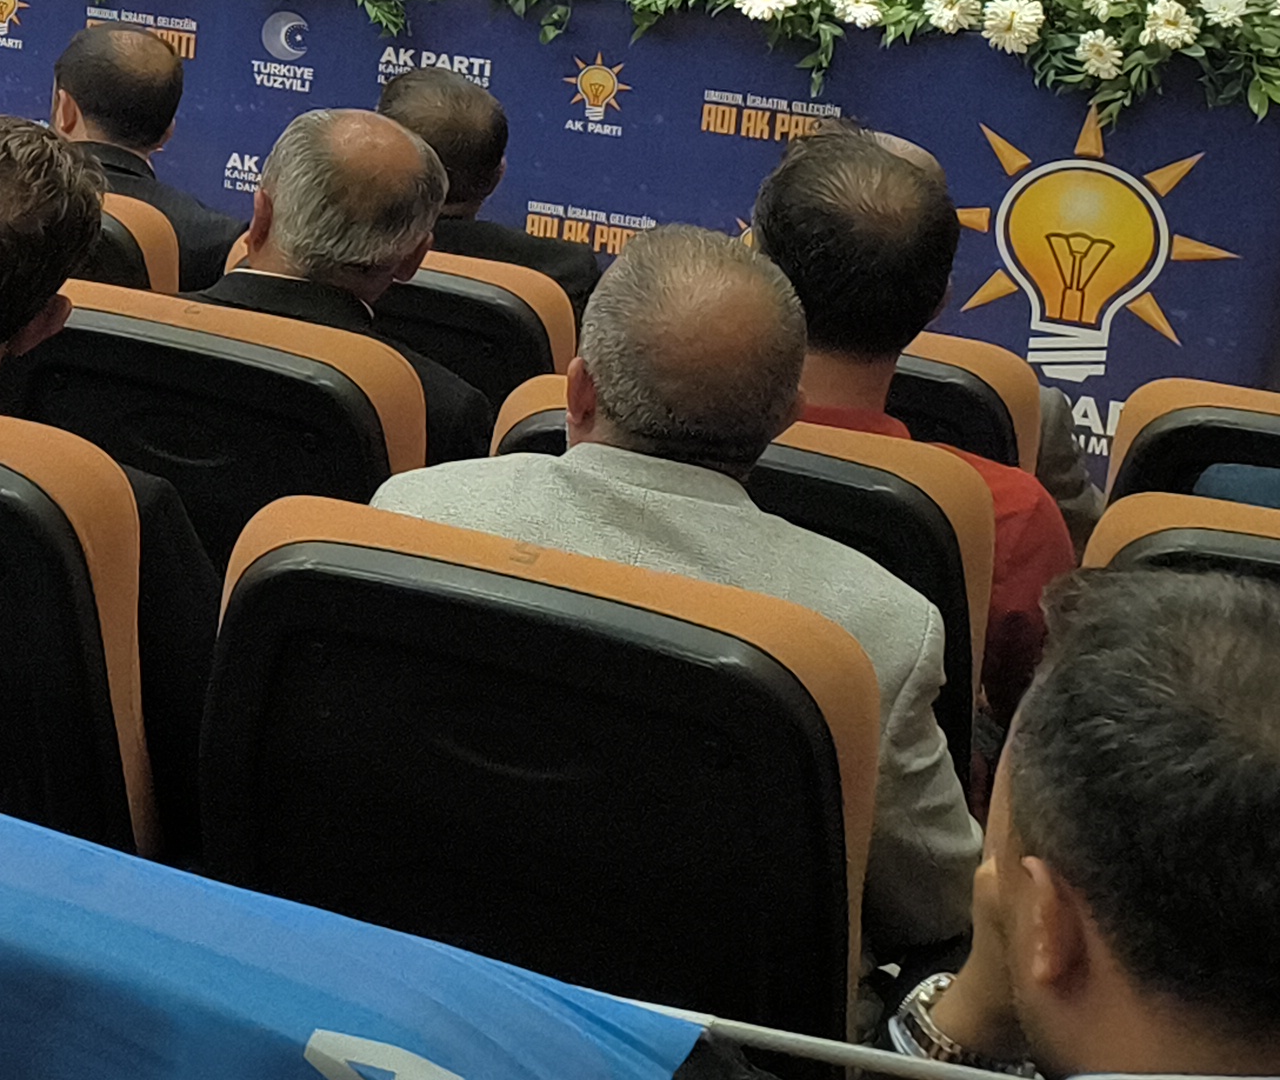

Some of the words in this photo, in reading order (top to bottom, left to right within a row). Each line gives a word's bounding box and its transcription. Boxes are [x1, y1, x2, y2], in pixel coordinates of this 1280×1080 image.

[380, 46, 416, 67] AK
[565, 120, 584, 132] AK
[701, 103, 737, 135] ADI
[741, 108, 771, 140] AK
[226, 152, 260, 173] AK
[562, 220, 590, 244] AK
